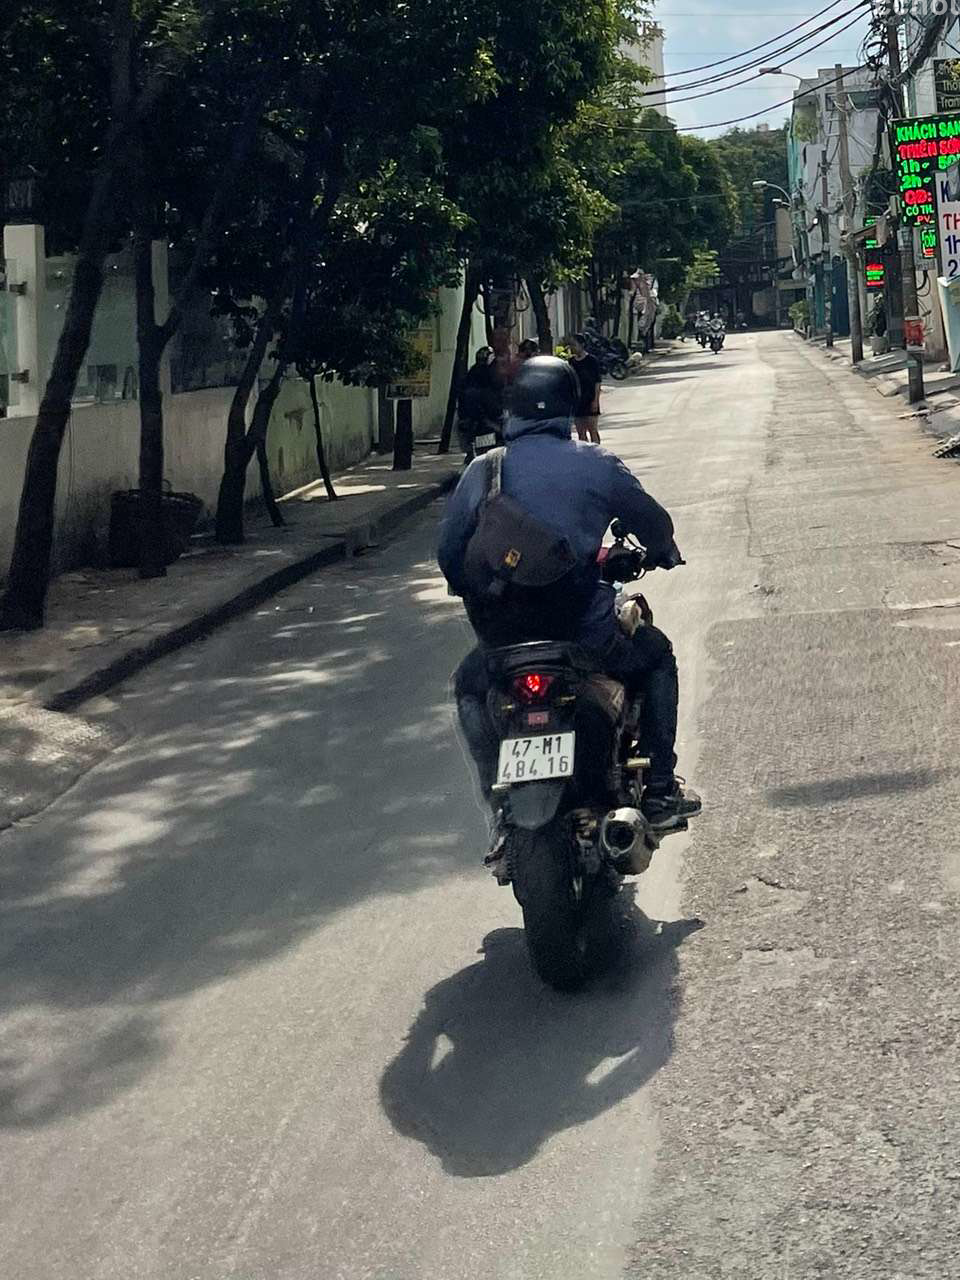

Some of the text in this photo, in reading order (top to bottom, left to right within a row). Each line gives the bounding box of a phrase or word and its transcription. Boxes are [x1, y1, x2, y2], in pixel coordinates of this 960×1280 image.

[897, 120, 937, 142] KHÁCH
[901, 159, 920, 173] 1h
[901, 174, 922, 189] 2h
[512, 735, 562, 758] 47-M1
[502, 756, 568, 779] 484.16
